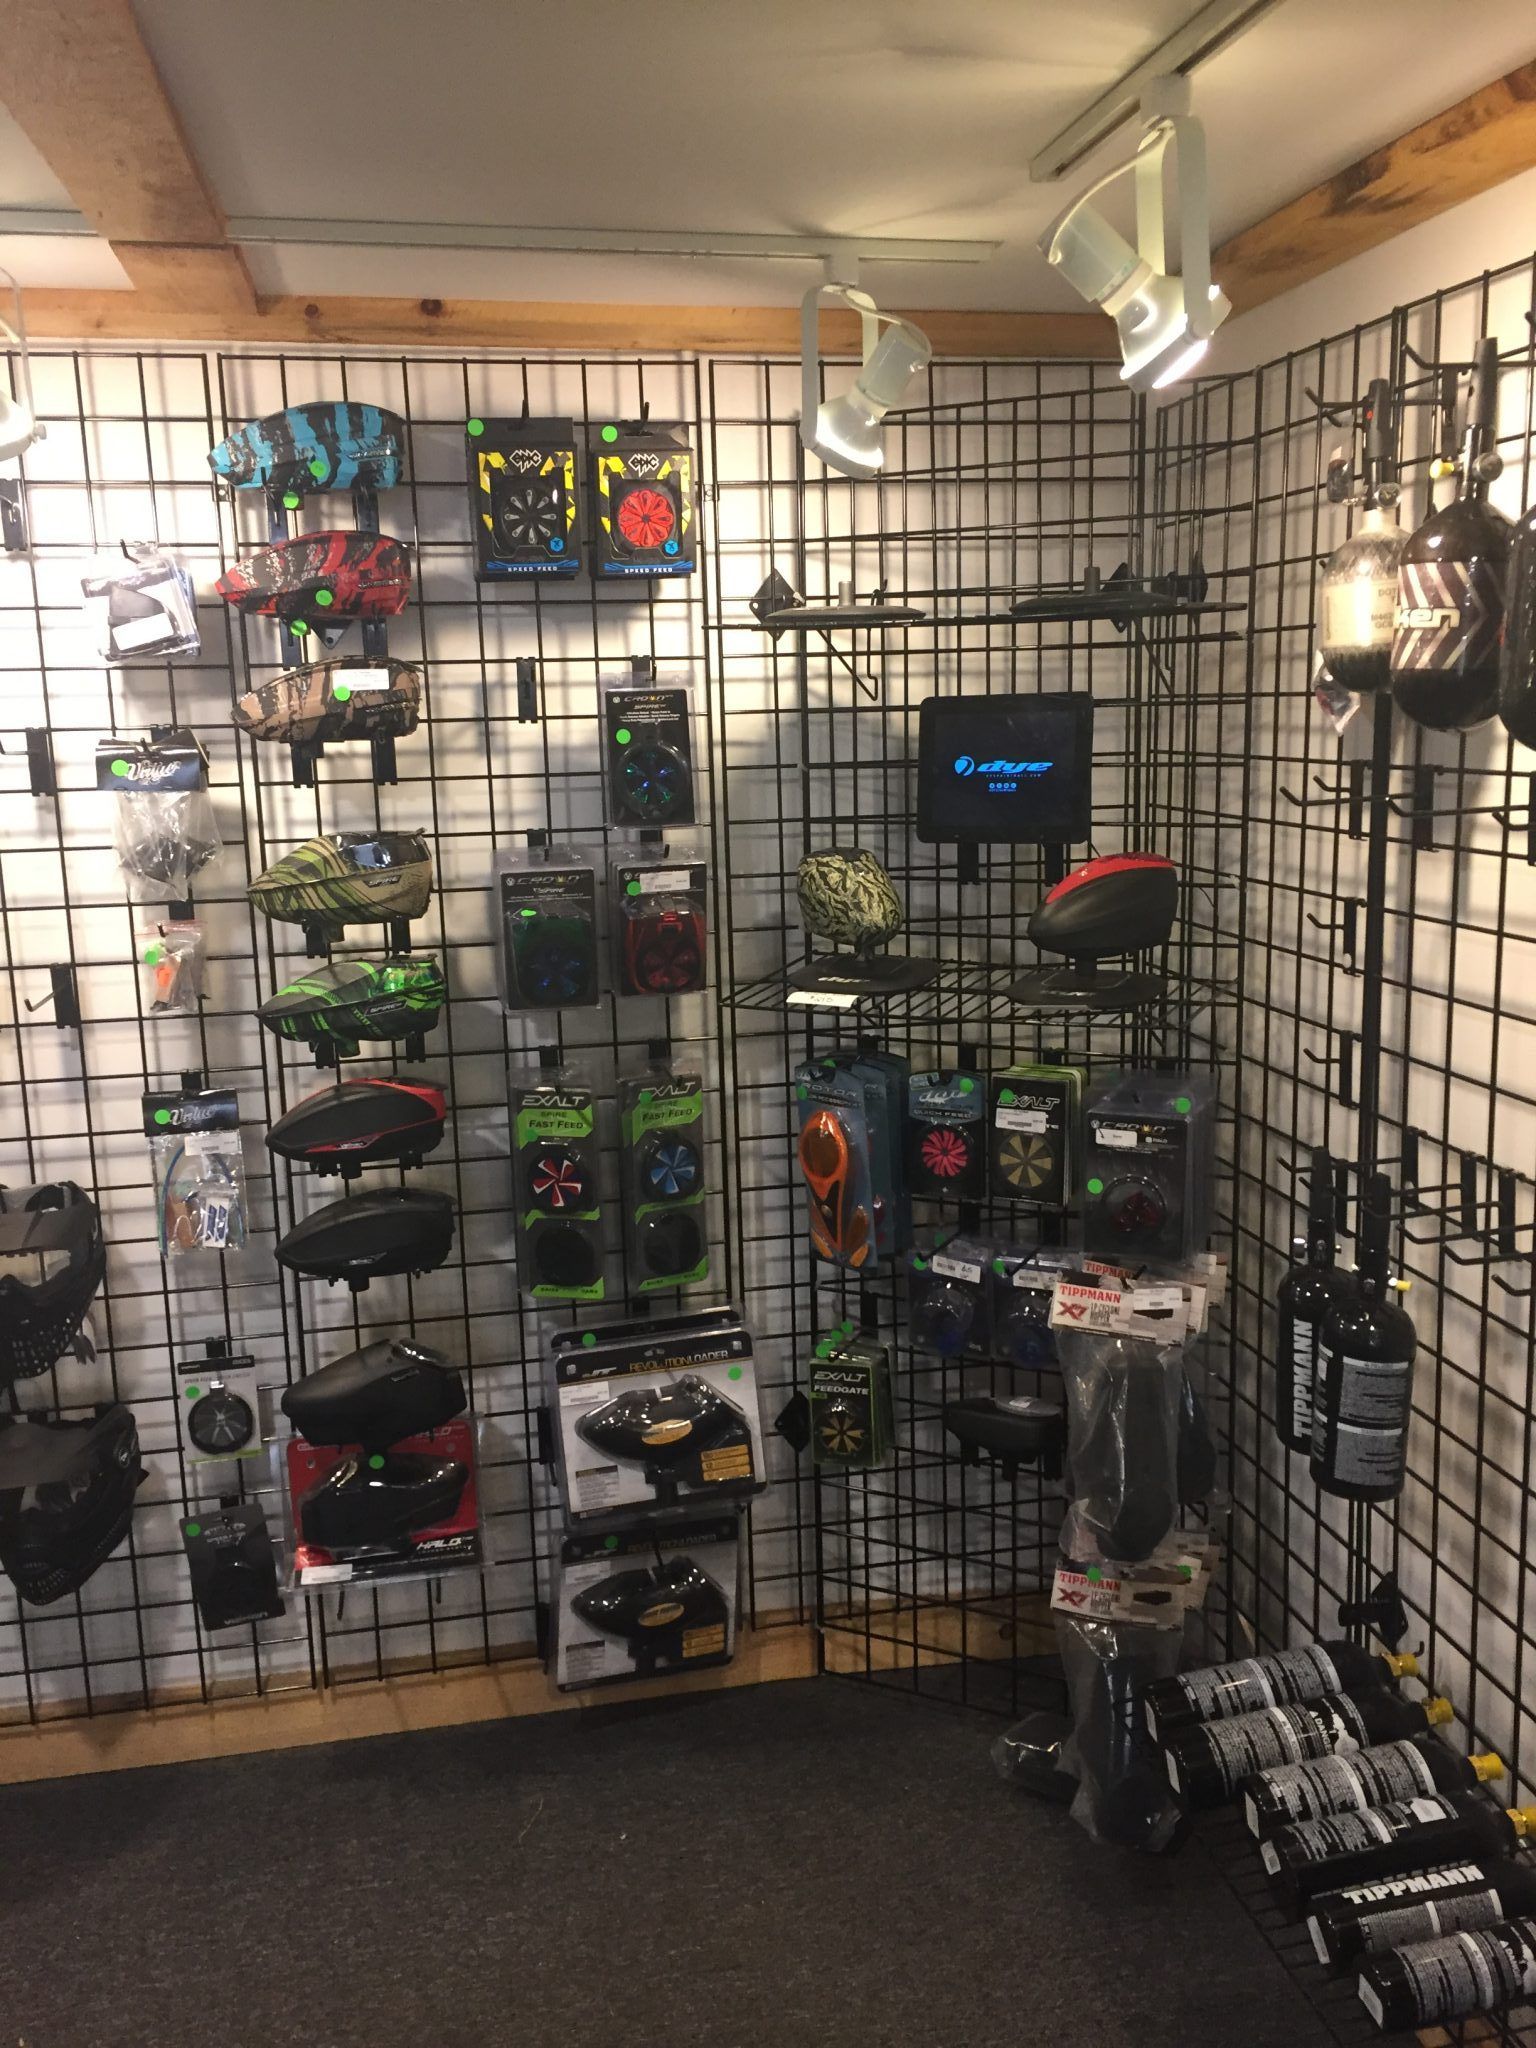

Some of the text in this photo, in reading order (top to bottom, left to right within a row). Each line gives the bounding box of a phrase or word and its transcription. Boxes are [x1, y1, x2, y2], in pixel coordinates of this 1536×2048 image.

[977, 760, 1053, 774] dye
[522, 1095, 584, 1106] EXALT
[642, 1108, 693, 1121] FAST FEED
[529, 1120, 584, 1129] FAST FEED
[1059, 1285, 1121, 1304] TIPPMANN
[814, 1371, 867, 1382] EXALT
[1293, 1318, 1312, 1438] TIPPMANN
[814, 1385, 870, 1395] FEEDGATE
[1342, 1864, 1485, 1905] TIPPMANN
